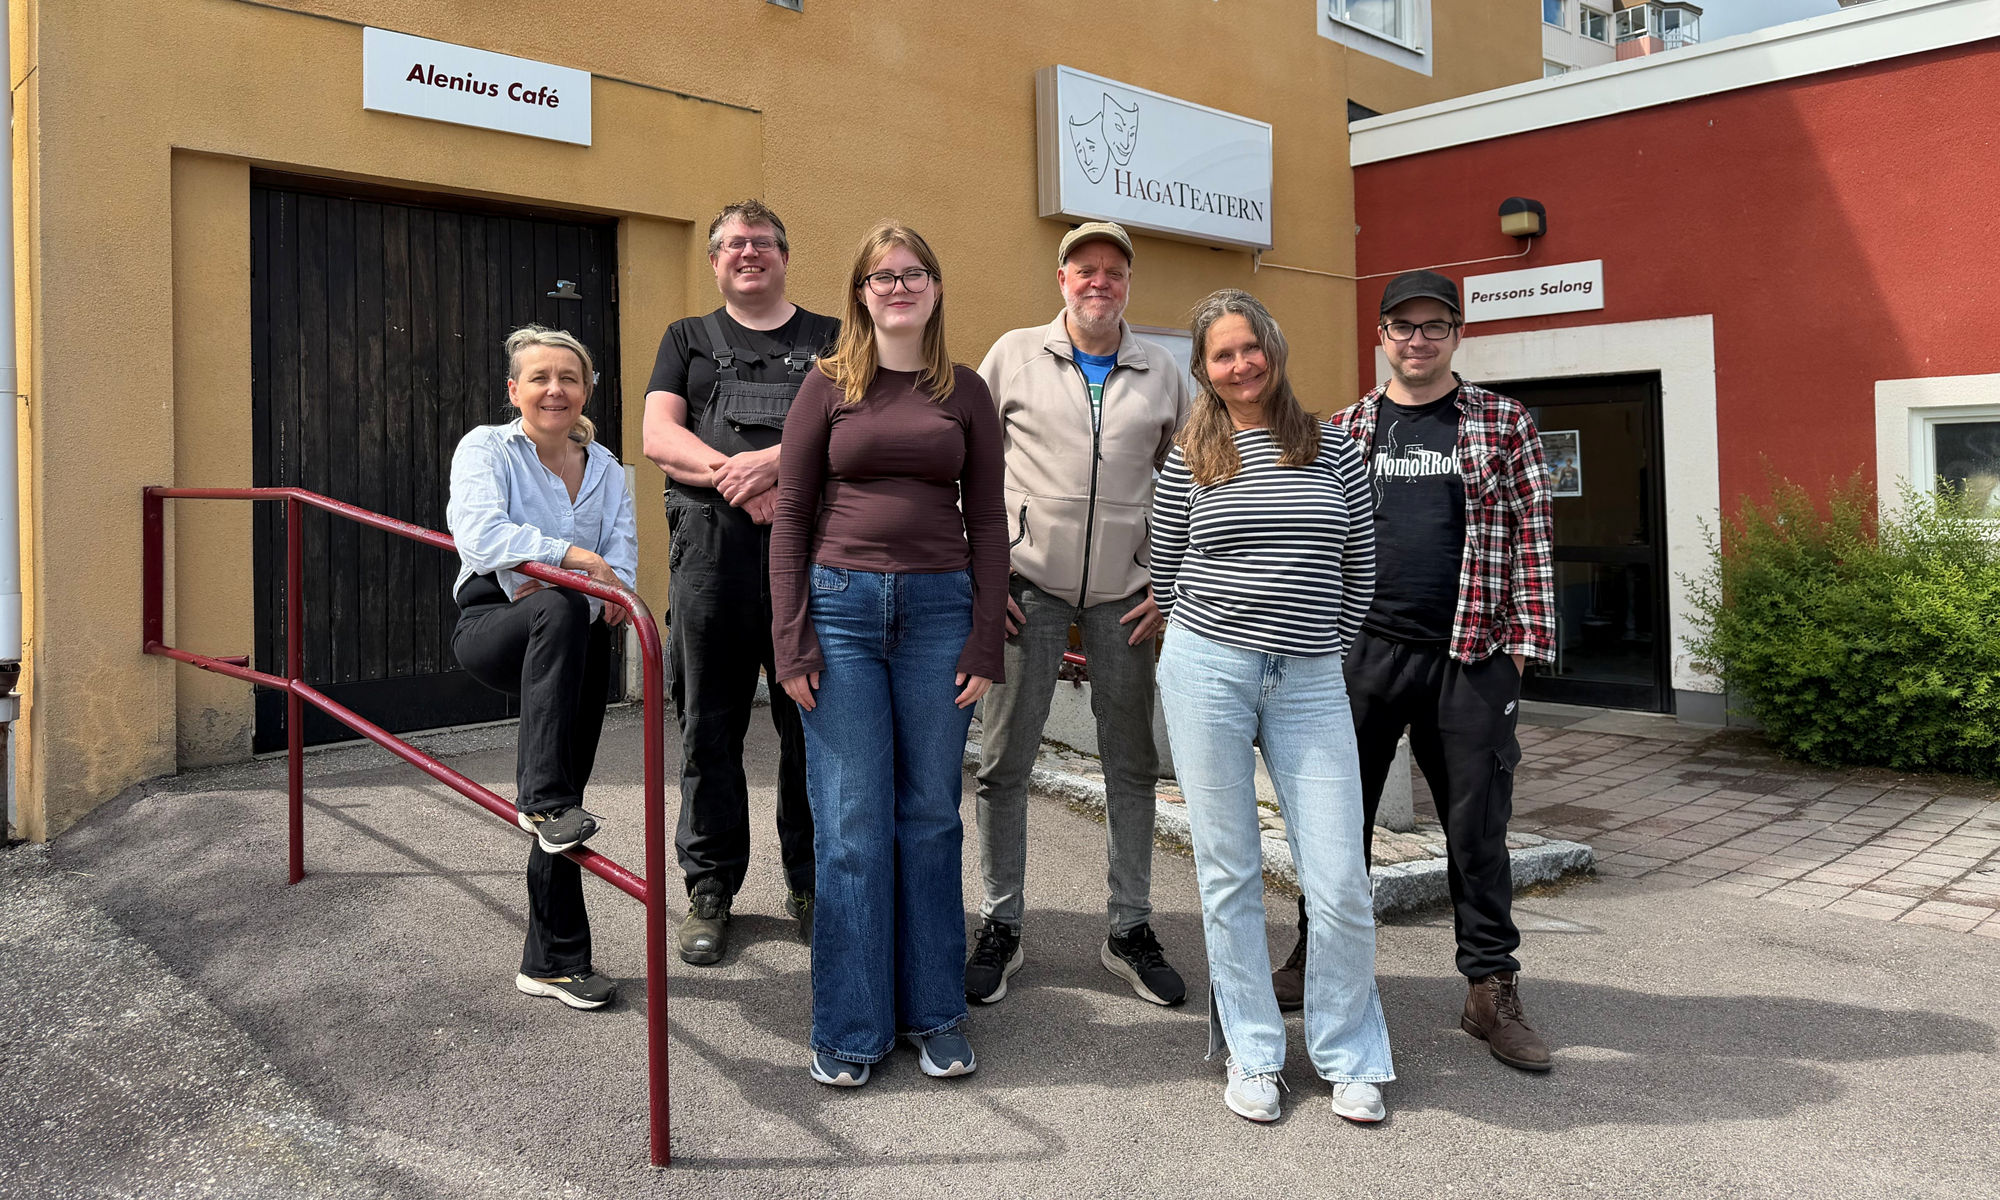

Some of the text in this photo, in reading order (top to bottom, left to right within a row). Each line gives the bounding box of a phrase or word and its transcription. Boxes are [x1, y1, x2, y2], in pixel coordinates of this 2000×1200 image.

[406, 63, 560, 109] Alenius Café
[1471, 279, 1593, 304] Perssons Salong
